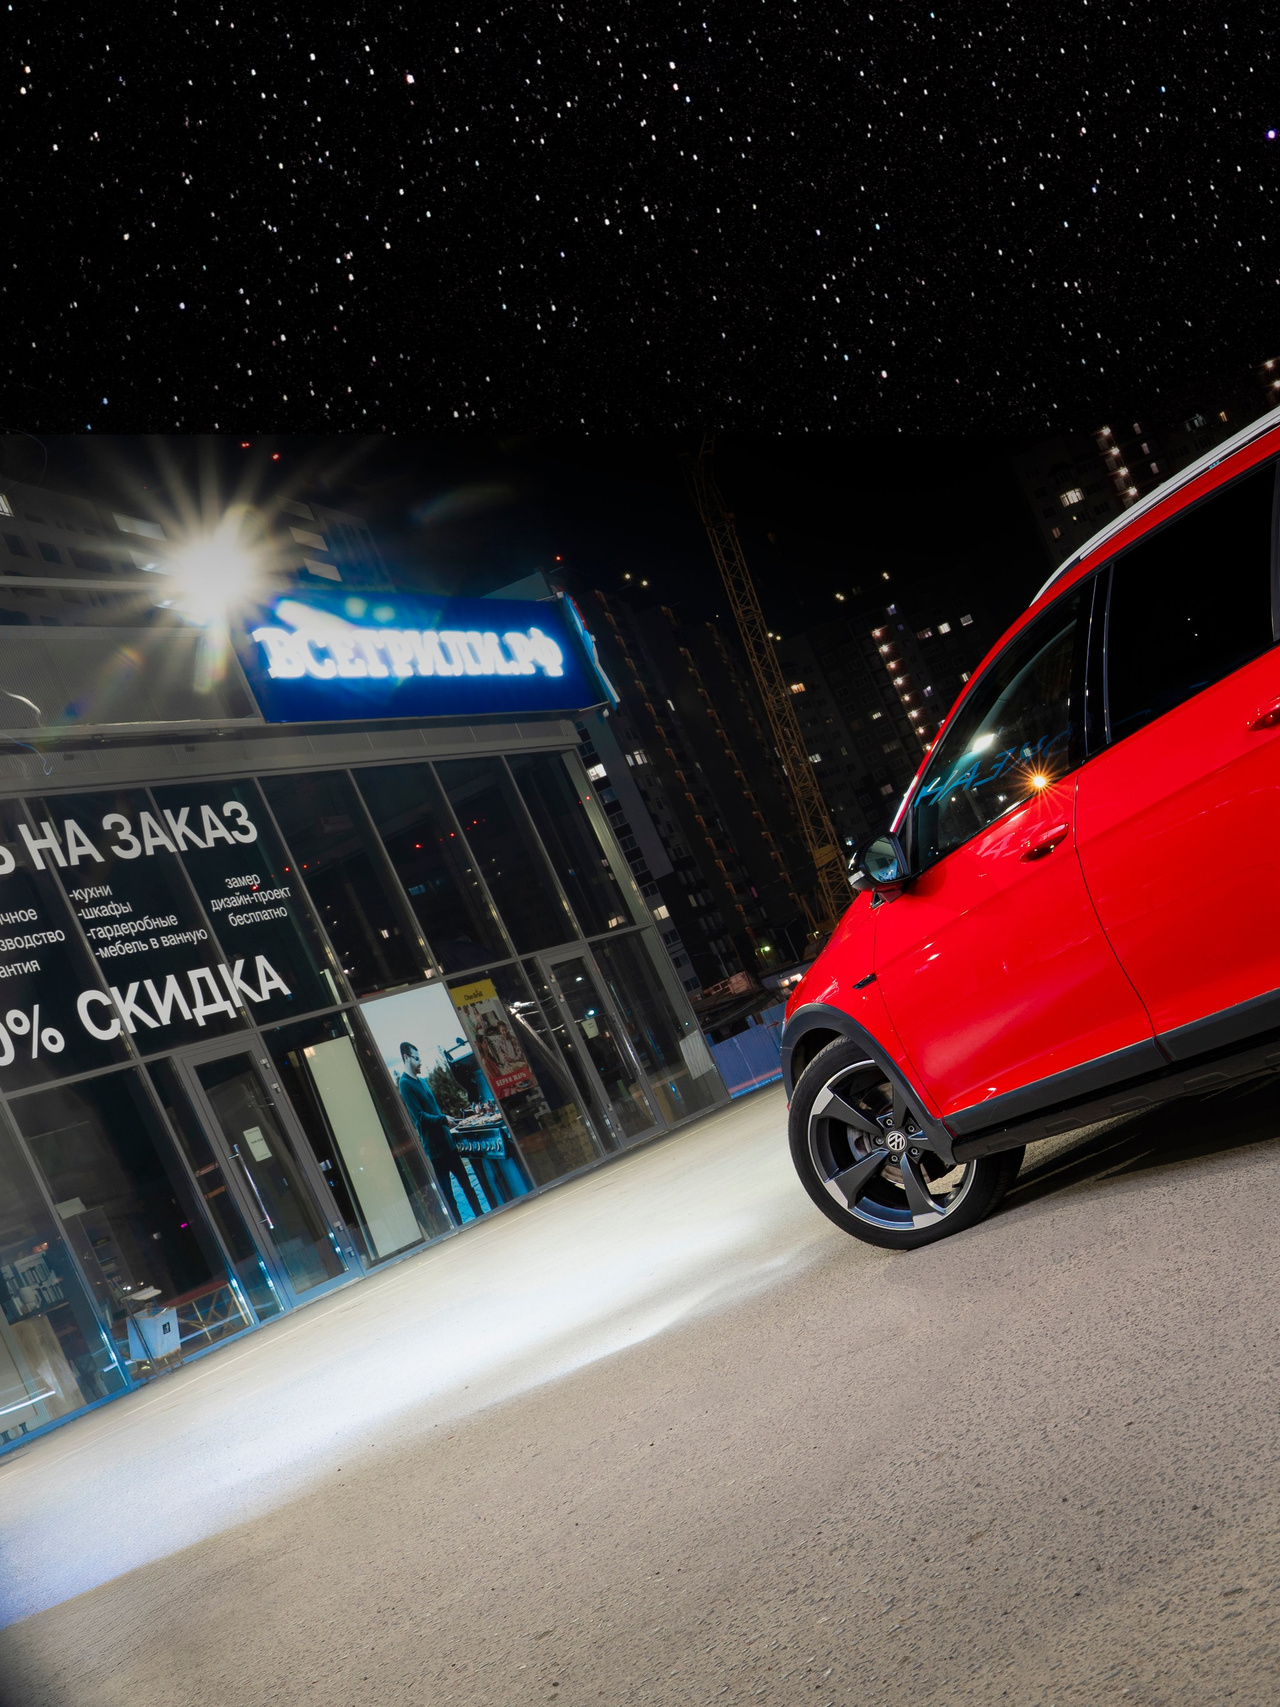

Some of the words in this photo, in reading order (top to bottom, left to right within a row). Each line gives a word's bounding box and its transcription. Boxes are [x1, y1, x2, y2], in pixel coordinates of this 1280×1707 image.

[18, 819, 105, 870] НА
[102, 801, 258, 860] ЗАКАЗ
[69, 884, 112, 902] -кухни
[225, 873, 261, 889] замер
[77, 900, 132, 920] -шкафы
[210, 885, 291, 912] дизайн-проект
[86, 913, 179, 941] -гардеробные
[228, 905, 288, 927] бесплатно
[94, 935, 149, 960] -мебель
[150, 937, 159, 950] в
[160, 927, 208, 947] ванную
[77, 955, 291, 1041] СКИДКА
